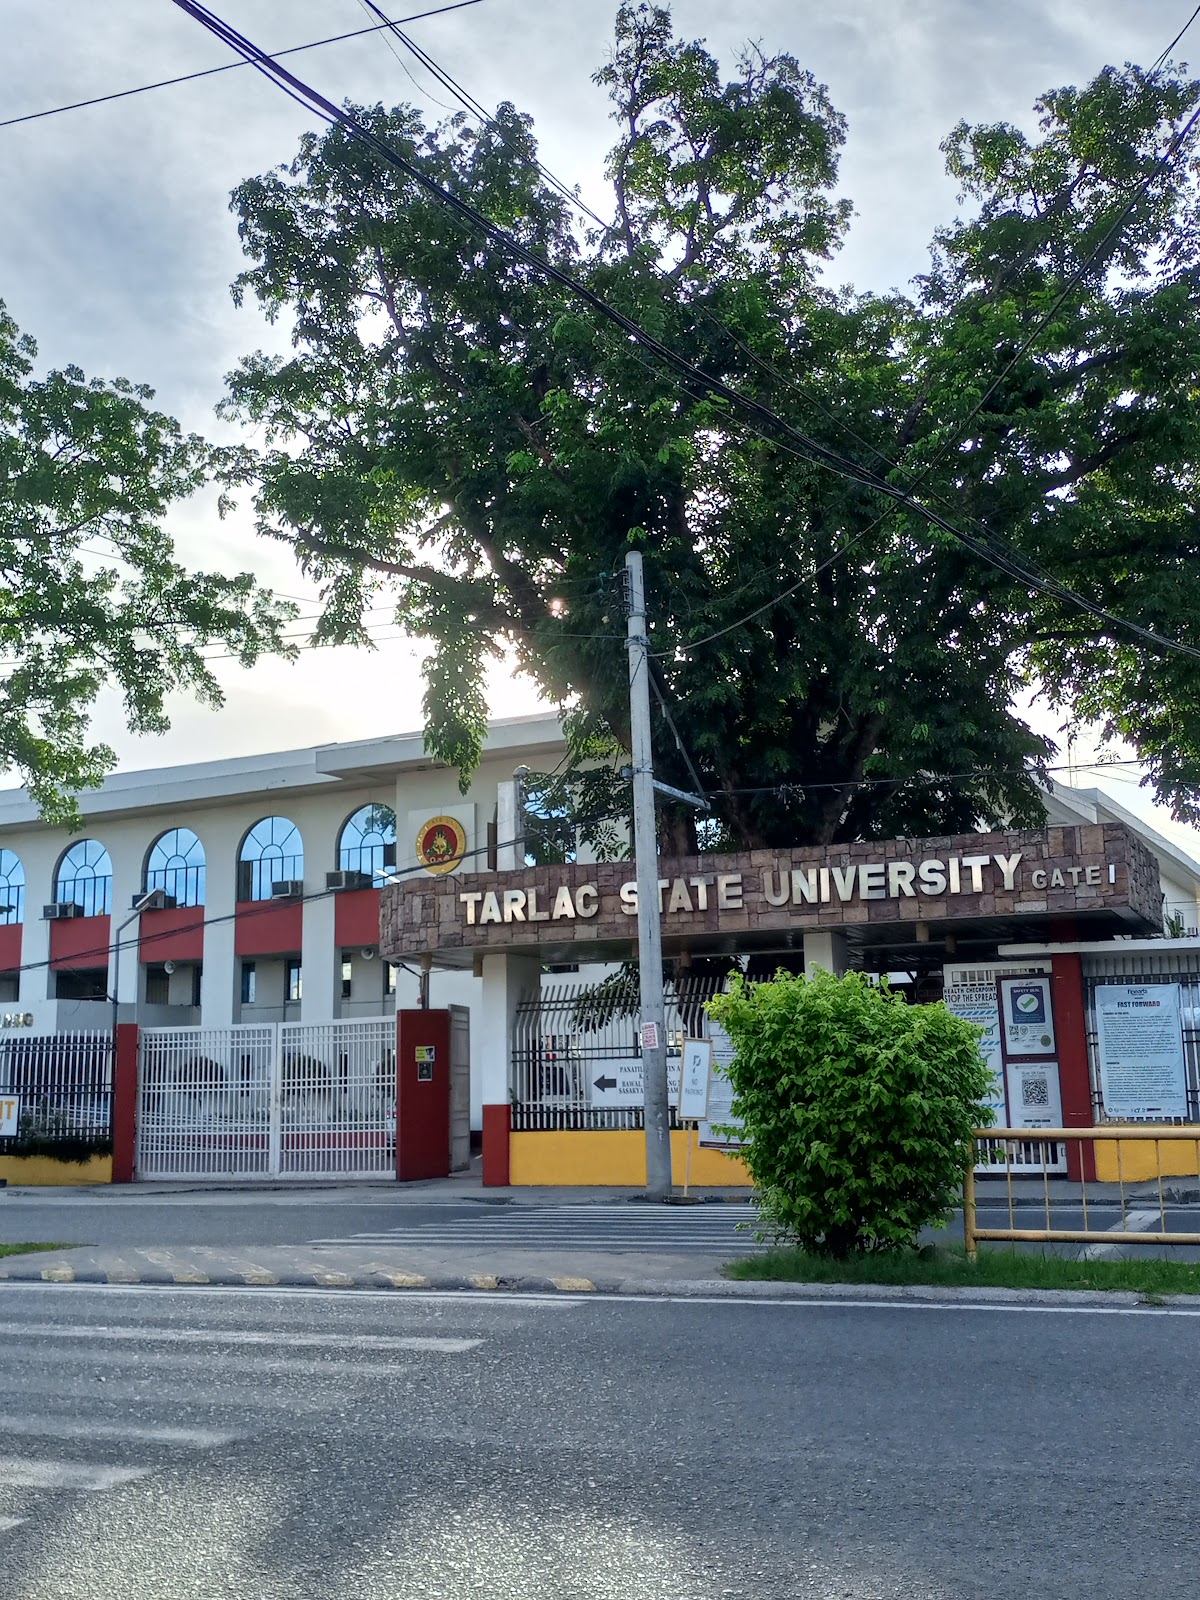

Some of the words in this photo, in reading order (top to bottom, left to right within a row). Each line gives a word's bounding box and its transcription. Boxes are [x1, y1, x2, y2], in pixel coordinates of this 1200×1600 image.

[460, 884, 598, 925] TARLAC
[619, 874, 743, 916] STATE
[763, 853, 1022, 906] UNIVERSITY
[1031, 865, 1102, 890] GATE
[945, 994, 961, 1003] STOP
[963, 994, 973, 1002] THE
[975, 993, 998, 1001] SPREAD
